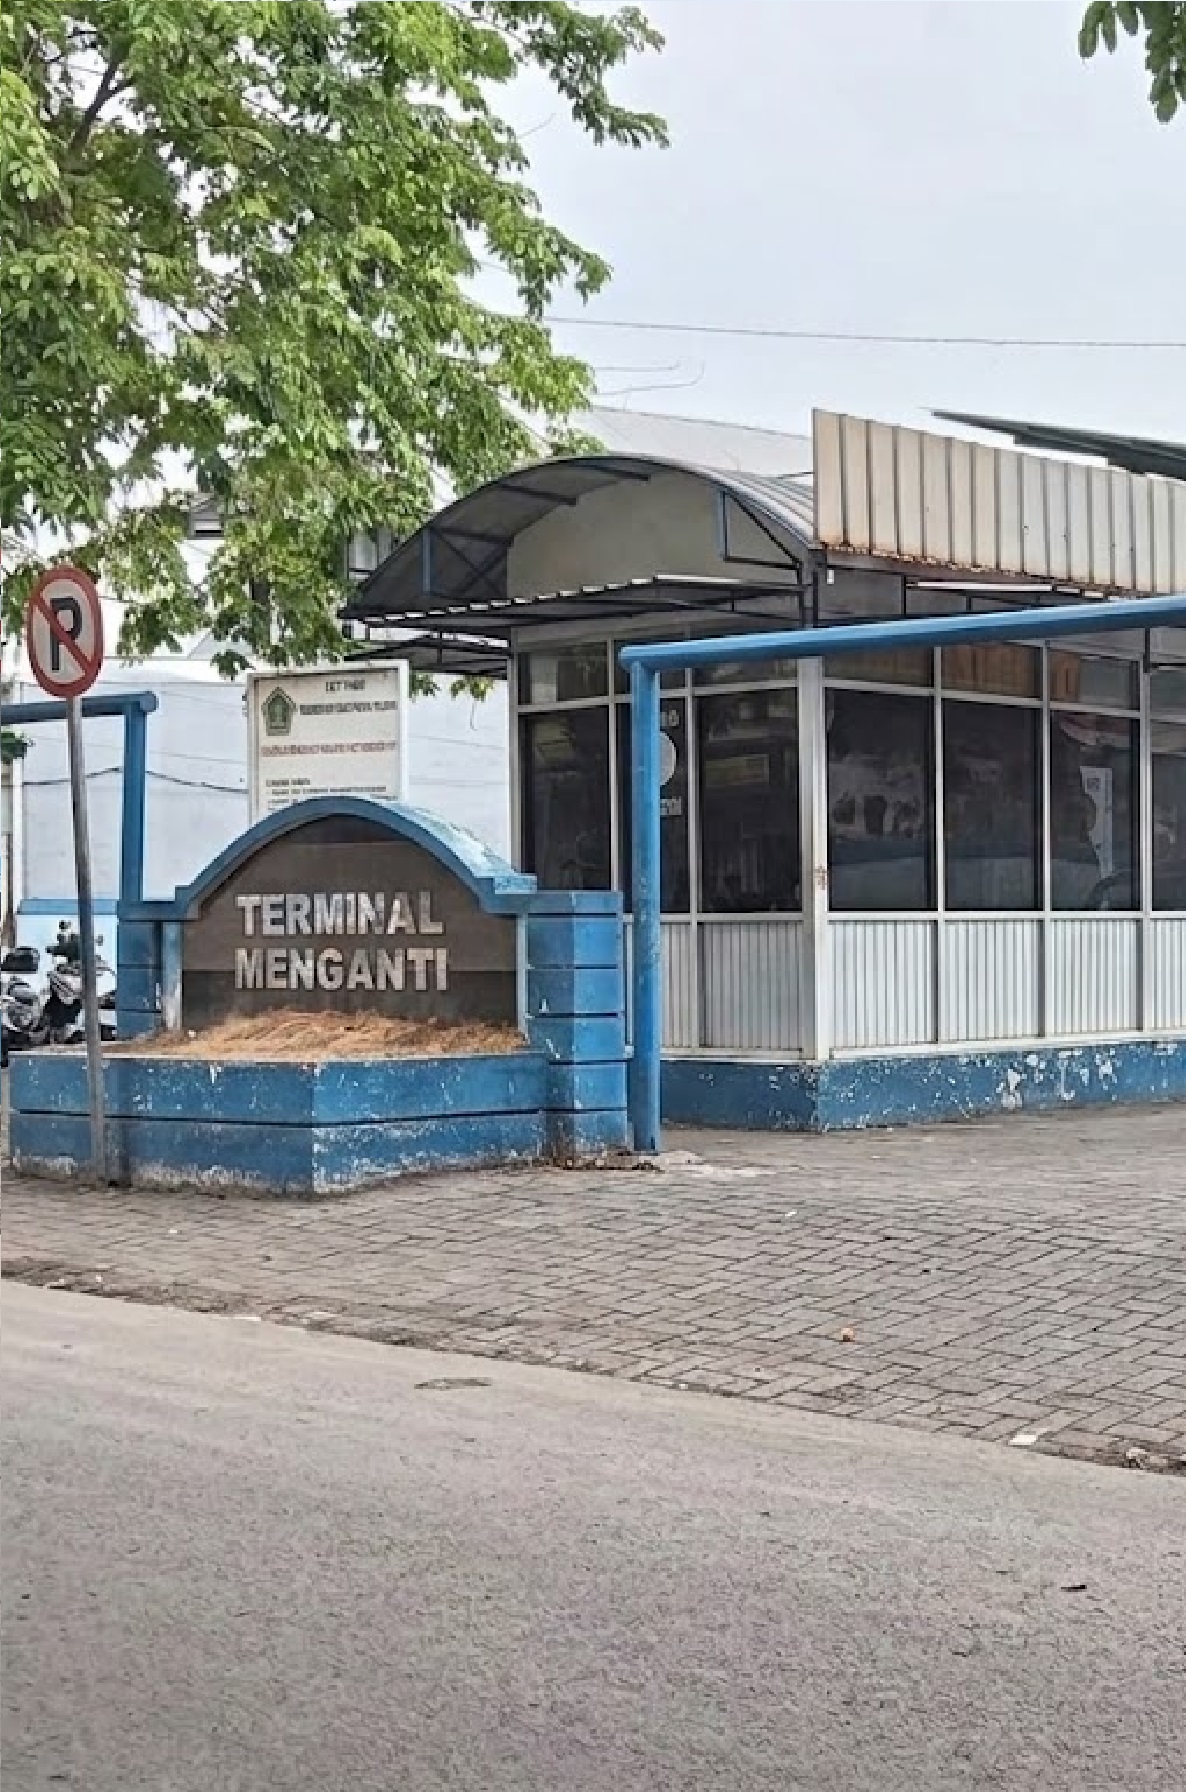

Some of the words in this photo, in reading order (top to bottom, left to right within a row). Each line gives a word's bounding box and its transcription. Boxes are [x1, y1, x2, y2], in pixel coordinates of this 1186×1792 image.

[50, 597, 82, 671] P
[235, 891, 444, 936] TERMINAL
[234, 947, 448, 991] MENGANTI
